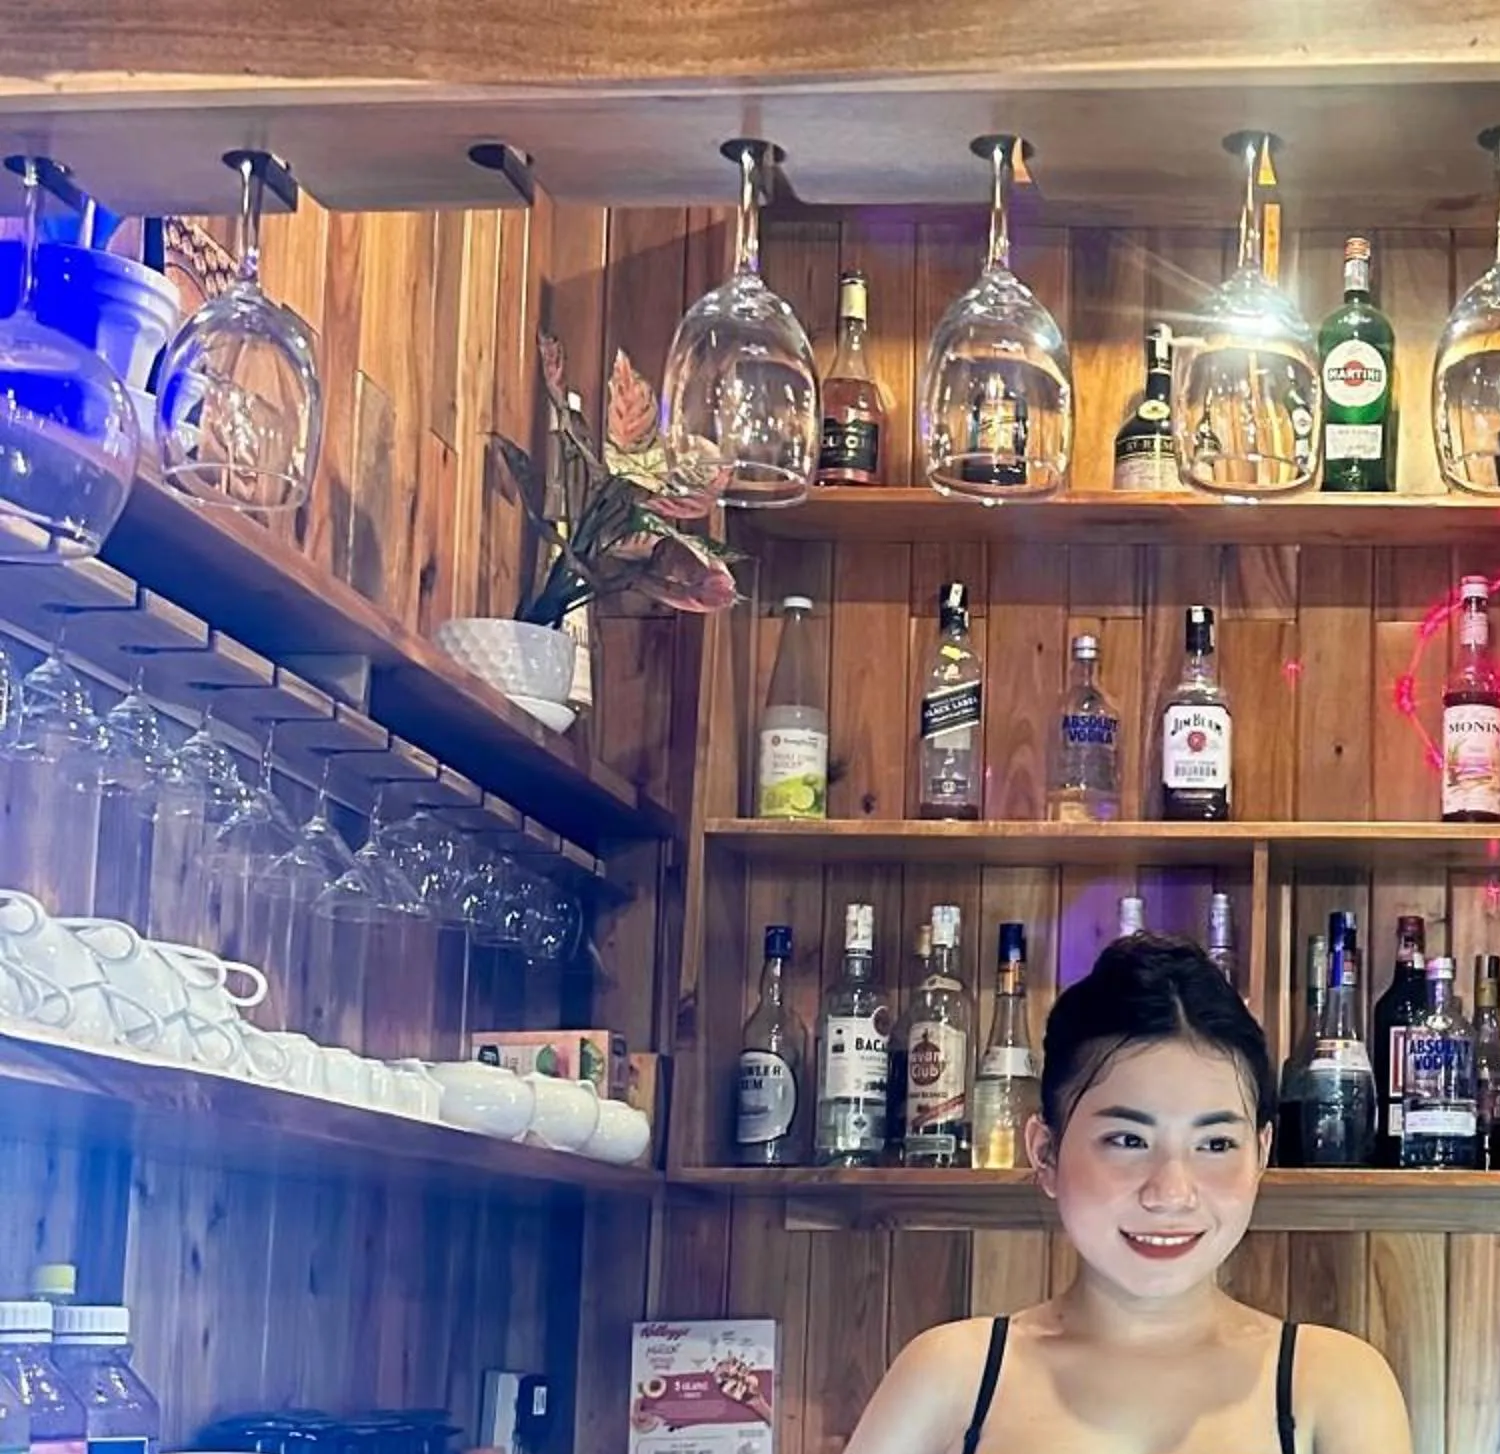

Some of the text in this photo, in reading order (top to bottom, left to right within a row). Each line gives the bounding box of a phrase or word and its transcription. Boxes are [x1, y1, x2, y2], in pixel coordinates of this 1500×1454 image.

[1327, 367, 1383, 382] MARTINI
[1062, 714, 1120, 733] ABSOLUT
[1069, 728, 1114, 745] VODKA
